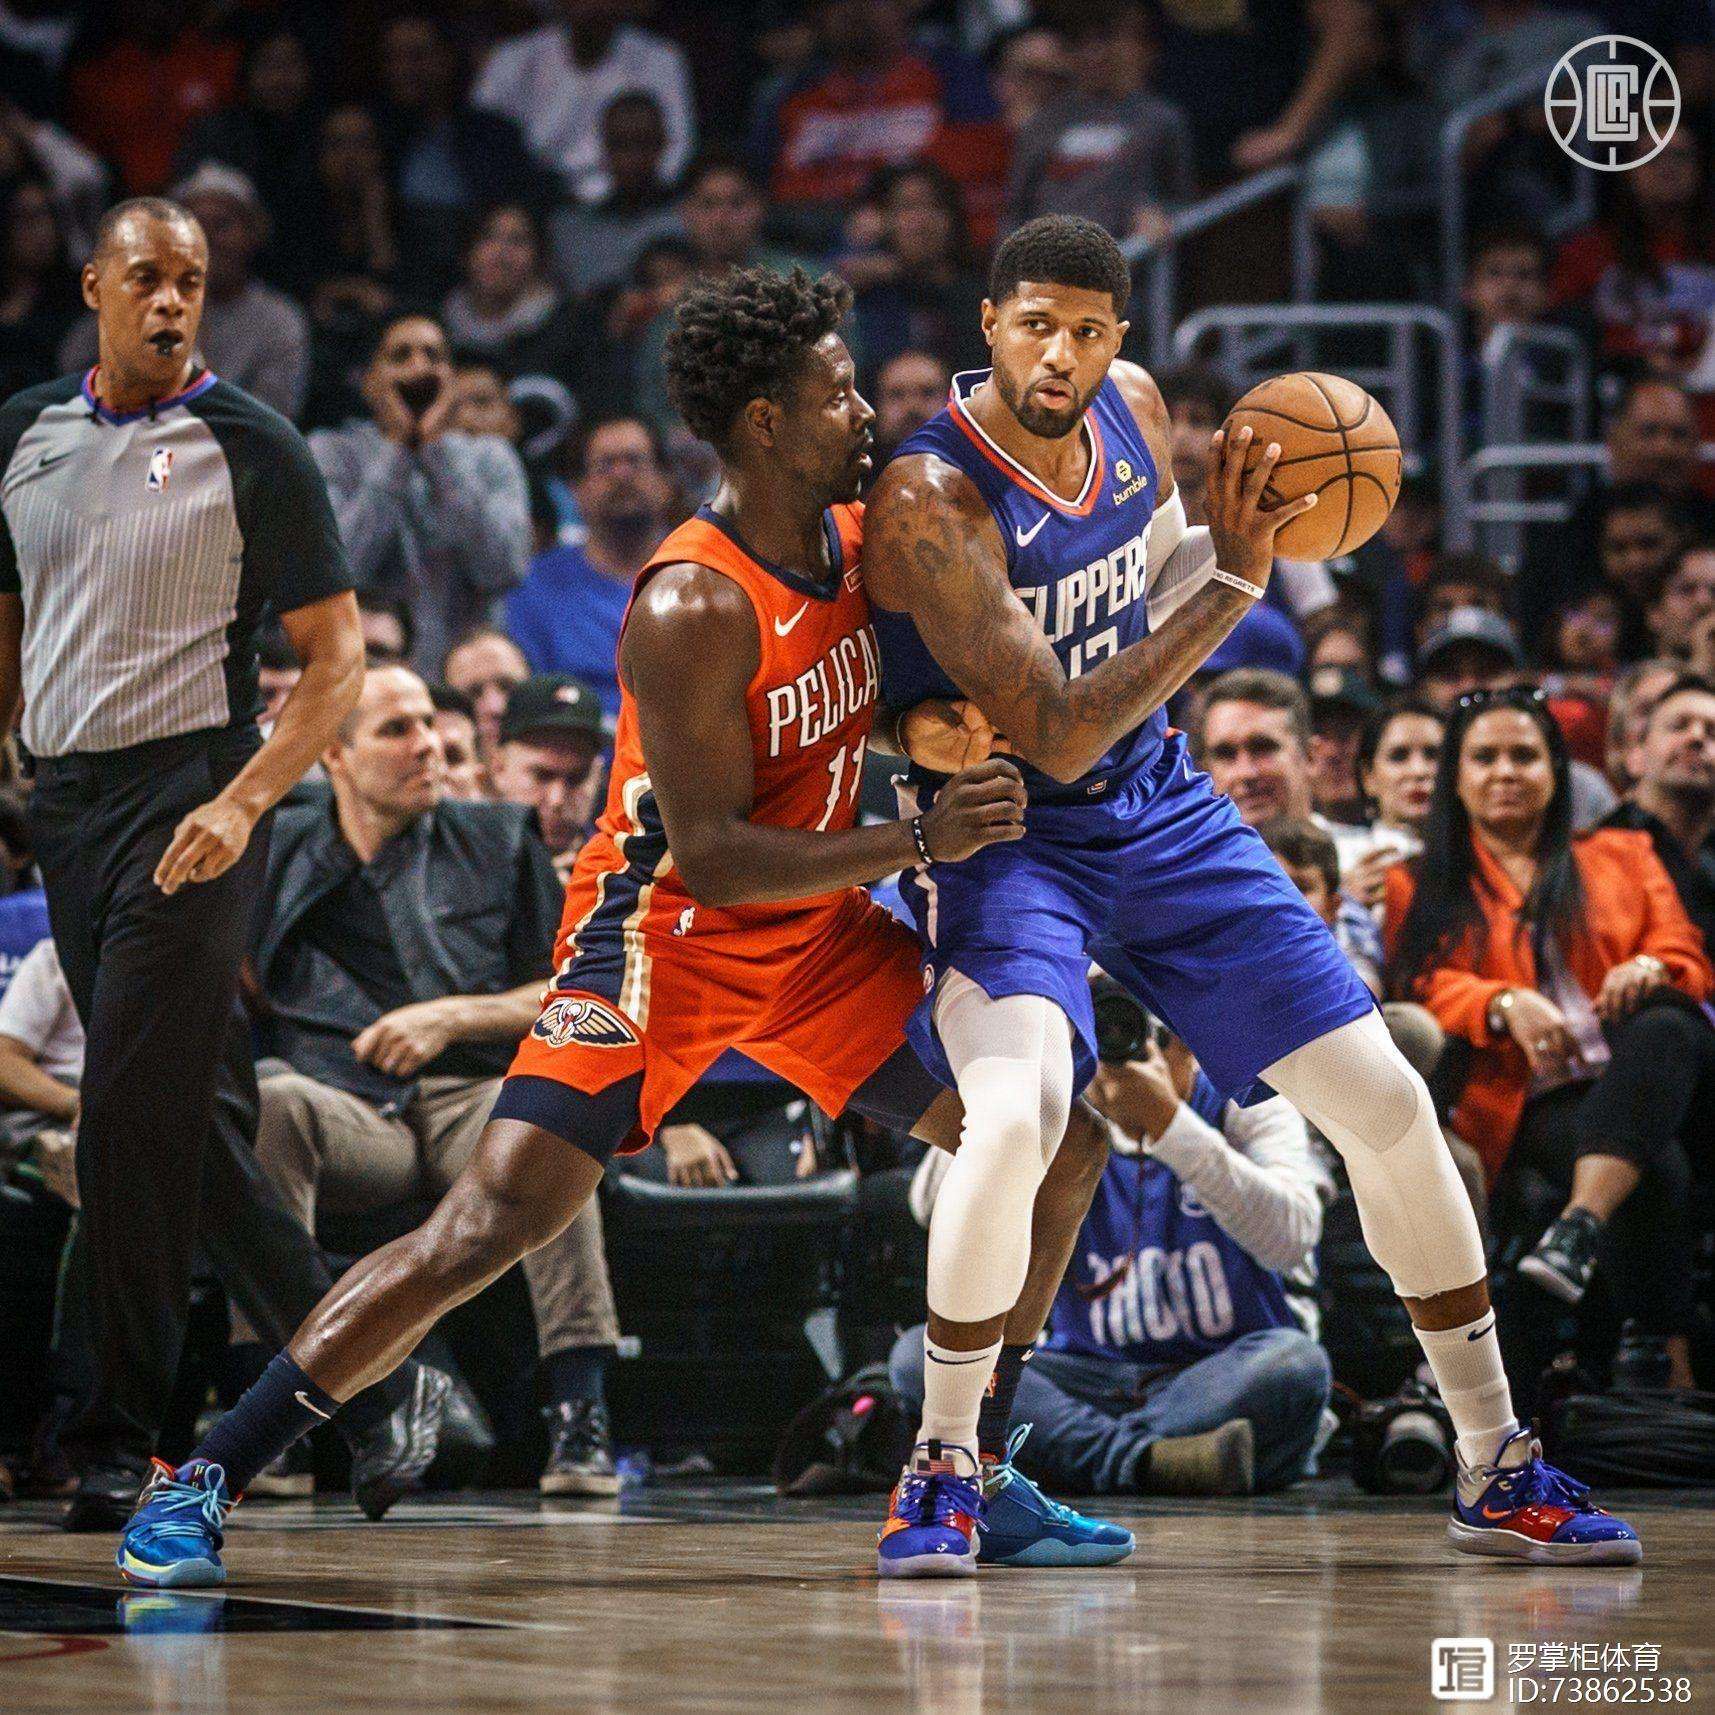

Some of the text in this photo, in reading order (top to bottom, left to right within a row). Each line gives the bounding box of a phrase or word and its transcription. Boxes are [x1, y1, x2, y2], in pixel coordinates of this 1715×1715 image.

[1112, 475, 1148, 506] bumble
[1014, 520, 1153, 645] LIPPERS
[766, 624, 882, 758] PELICA
